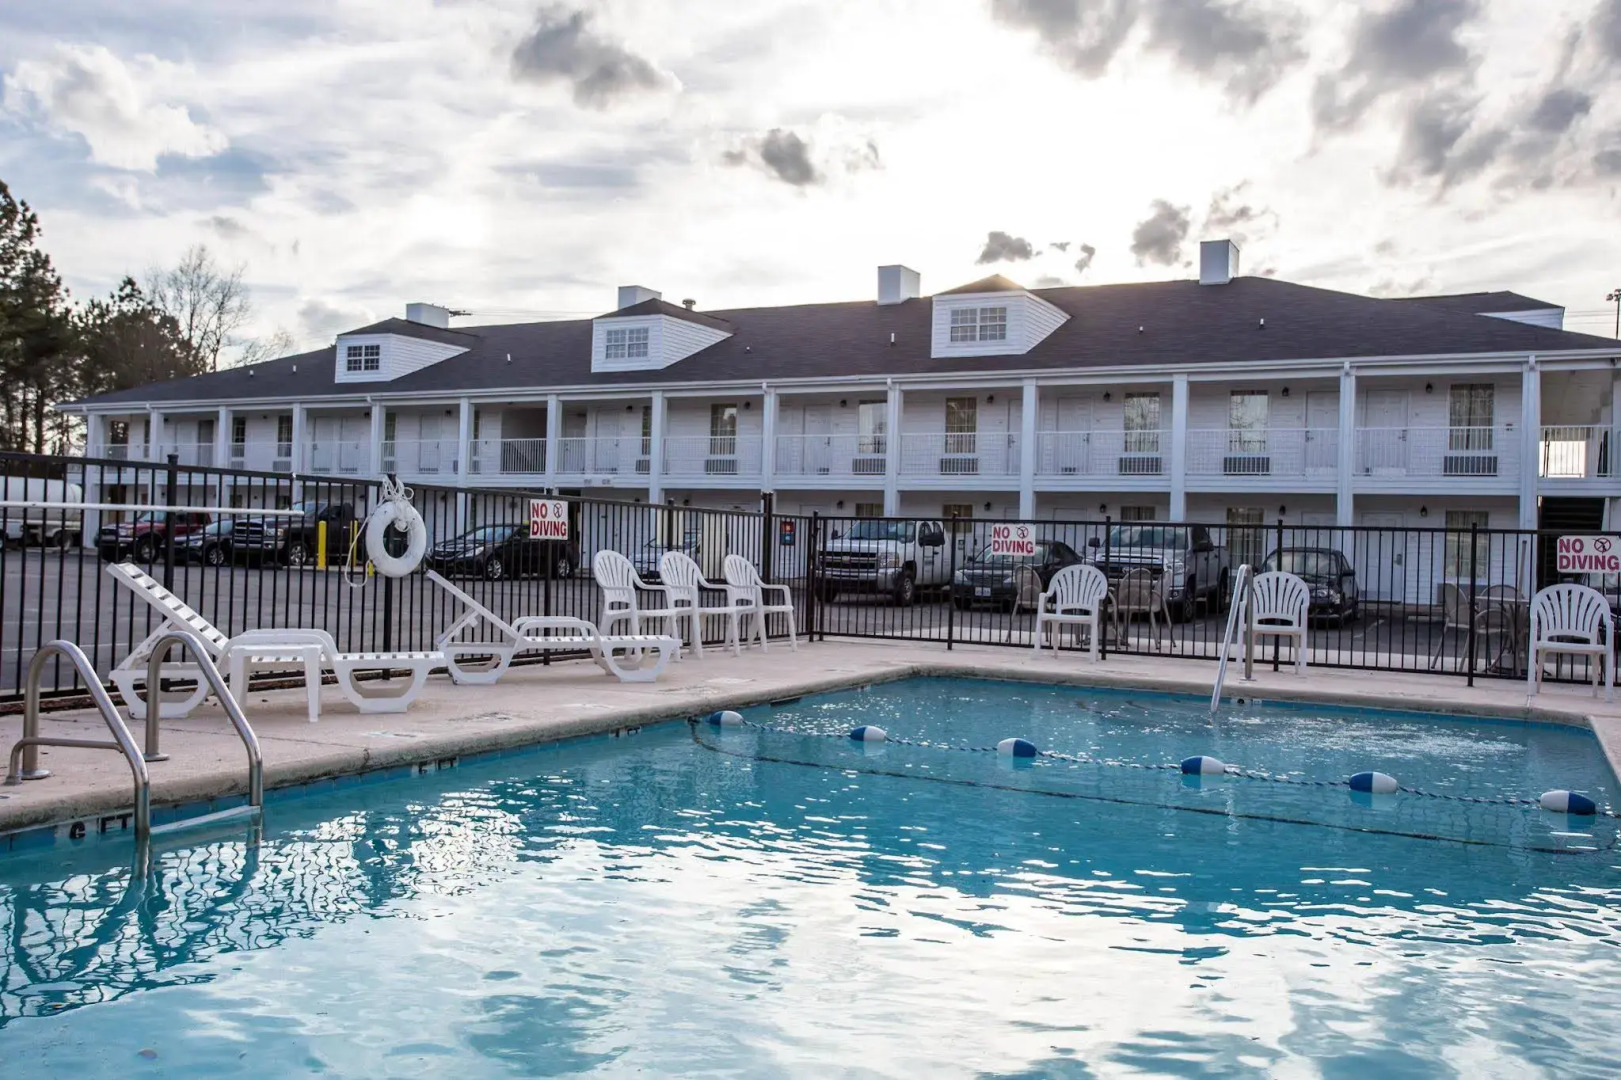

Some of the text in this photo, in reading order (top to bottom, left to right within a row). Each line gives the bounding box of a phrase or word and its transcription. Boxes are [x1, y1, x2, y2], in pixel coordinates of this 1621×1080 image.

[532, 503, 548, 519] NO
[531, 520, 567, 537] DIVING
[993, 526, 1010, 539] NO
[992, 540, 1034, 554] DIVING
[1558, 538, 1584, 554] NO
[1558, 554, 1620, 571] DIVING
